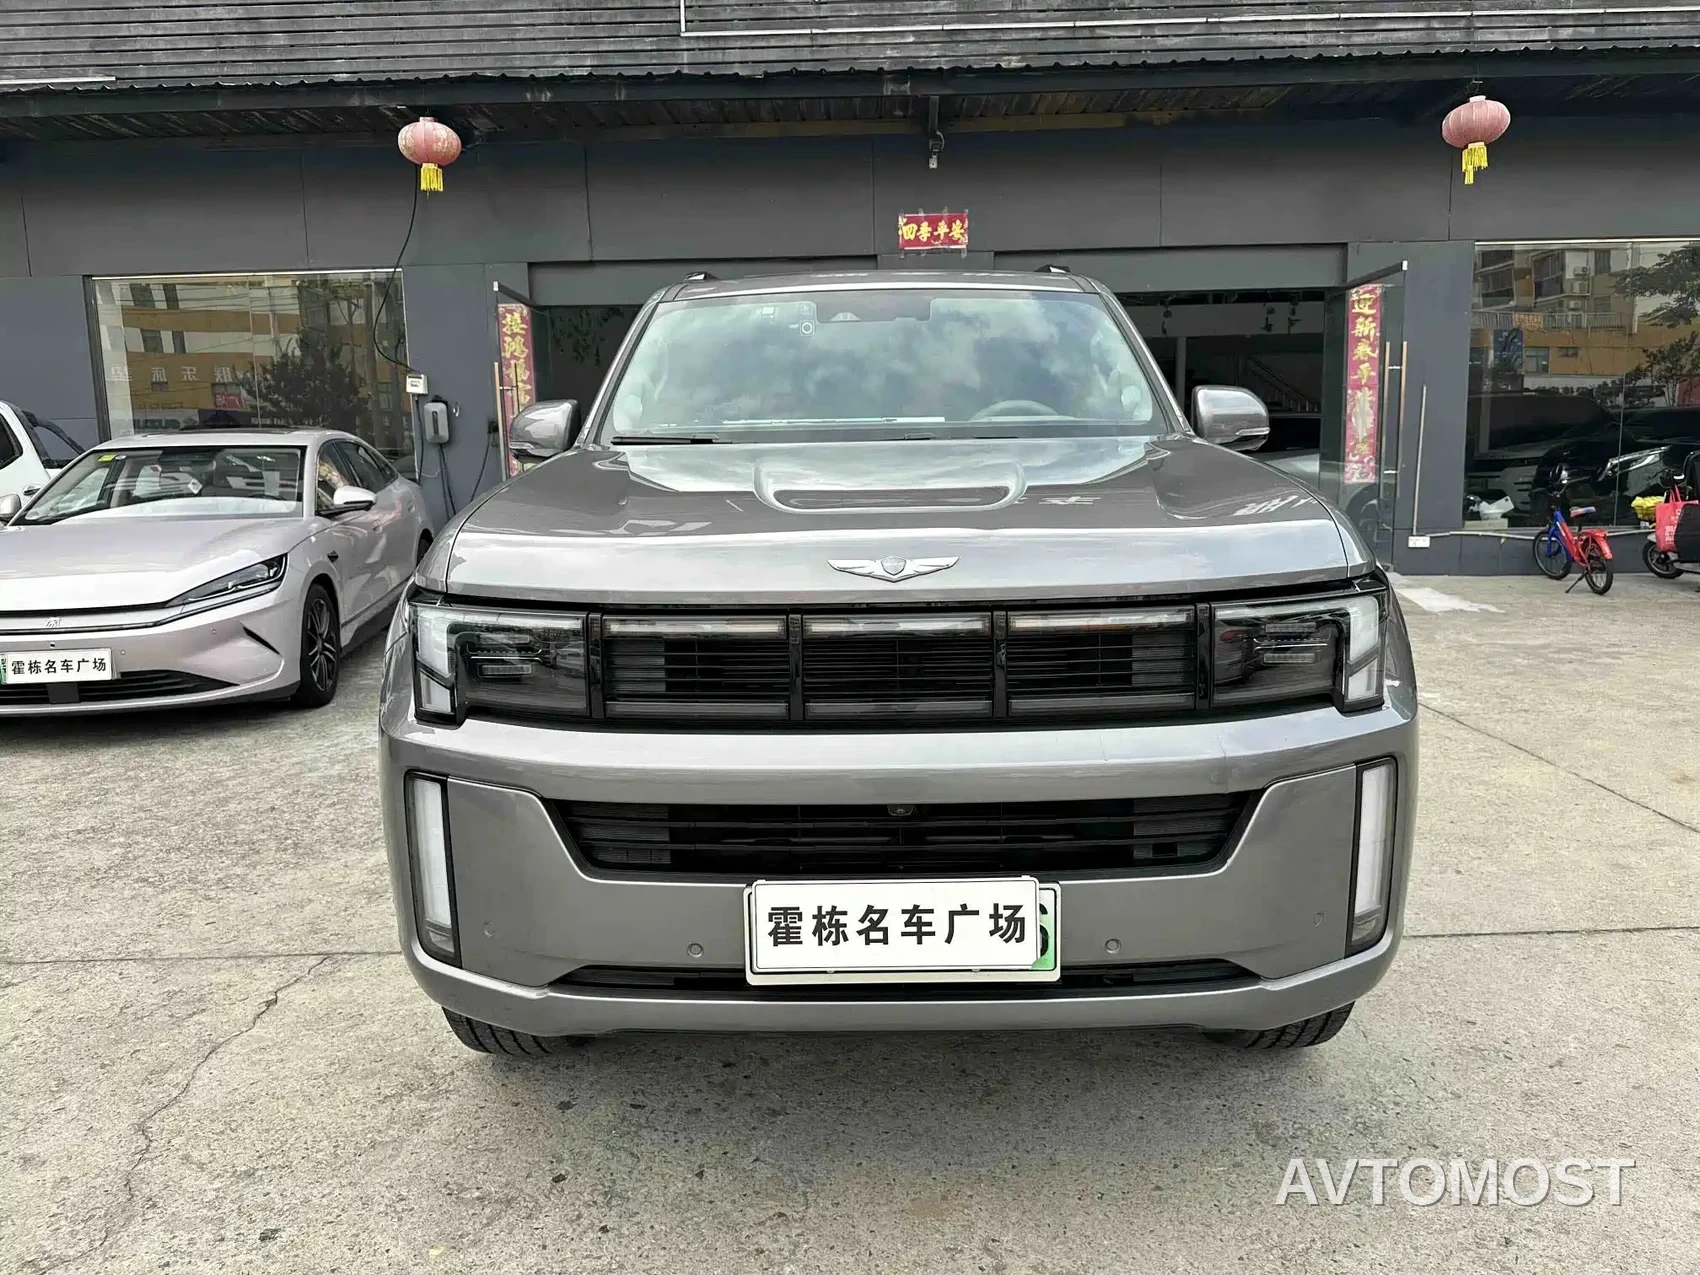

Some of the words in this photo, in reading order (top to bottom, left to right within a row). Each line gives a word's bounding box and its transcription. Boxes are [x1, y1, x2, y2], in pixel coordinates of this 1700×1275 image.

[902, 219, 965, 242] 四季平安
[12, 658, 106, 675] 霍栋名车广场
[768, 903, 1026, 946] 霍栋名车广场
